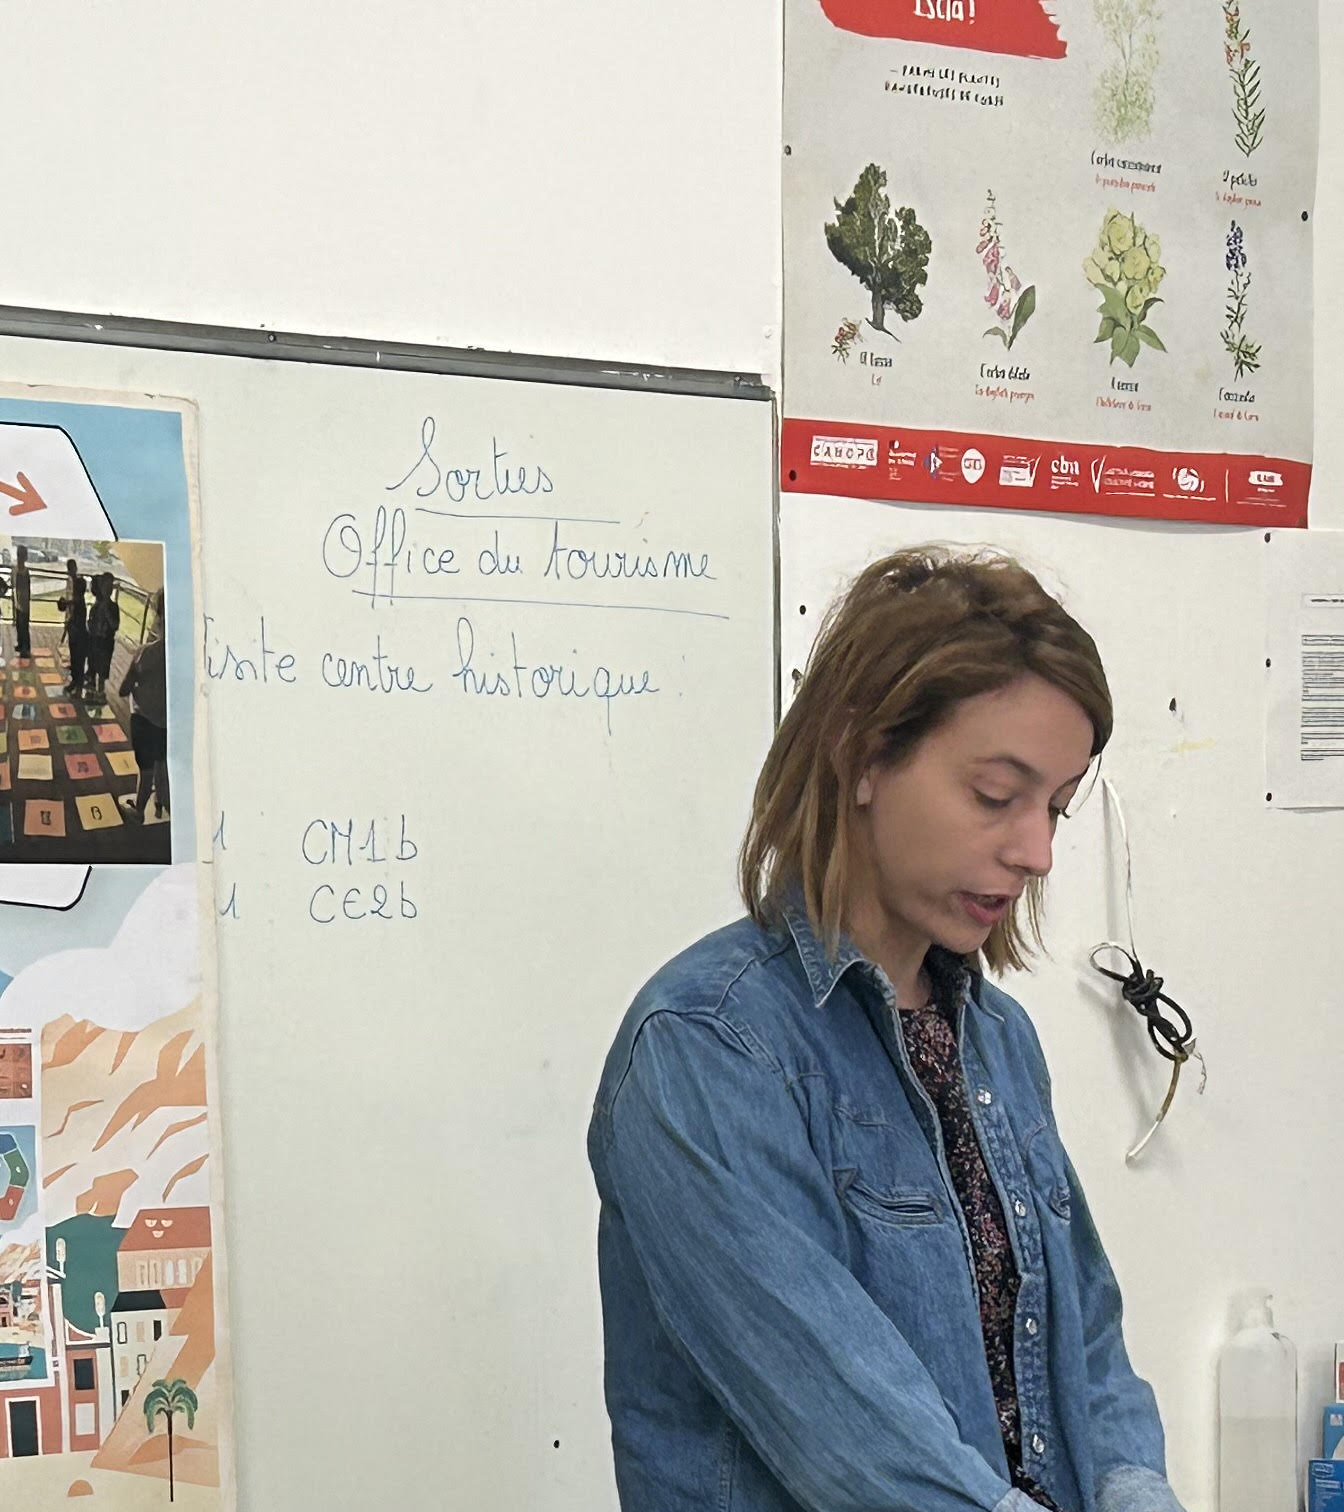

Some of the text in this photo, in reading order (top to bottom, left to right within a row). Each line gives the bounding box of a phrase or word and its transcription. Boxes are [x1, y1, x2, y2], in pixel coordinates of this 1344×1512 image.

[386, 416, 554, 501] Sorties
[322, 505, 718, 610] Office du tourisme
[322, 635, 434, 694] centre
[453, 616, 660, 736] historique
